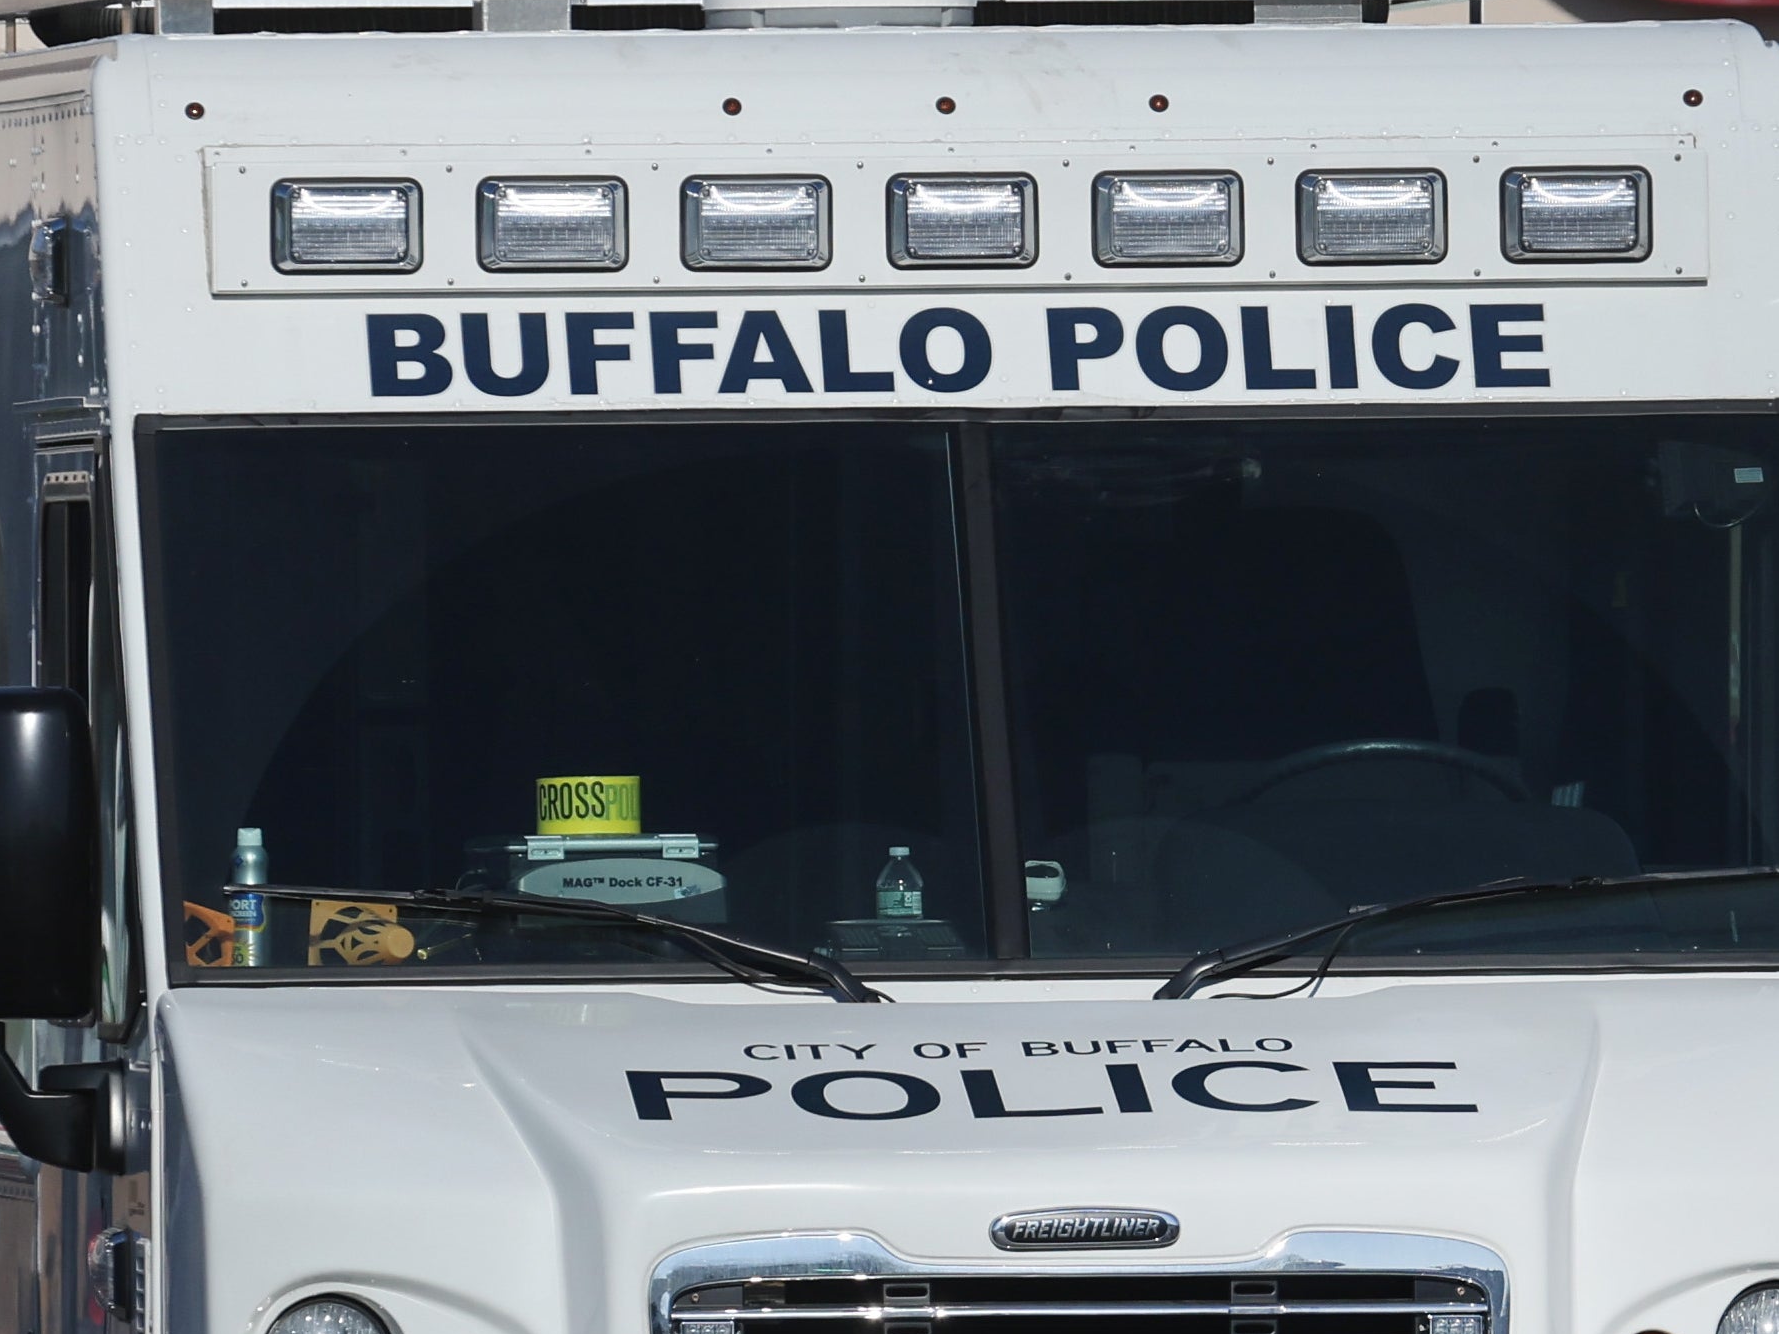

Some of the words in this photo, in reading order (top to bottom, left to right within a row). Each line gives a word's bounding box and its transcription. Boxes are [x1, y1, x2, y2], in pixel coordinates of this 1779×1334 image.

[365, 307, 993, 398] BUFFALO
[1045, 302, 1552, 392] POLICE
[539, 781, 605, 821] CROSS
[609, 876, 642, 888] Dock
[646, 876, 683, 887] CF-31
[743, 1043, 877, 1061] CITY
[913, 1042, 988, 1059] OF
[1022, 1037, 1294, 1057] BUFFALO
[624, 1060, 1479, 1121] POLICE
[1011, 1216, 1161, 1241] FREIGHTLINER
